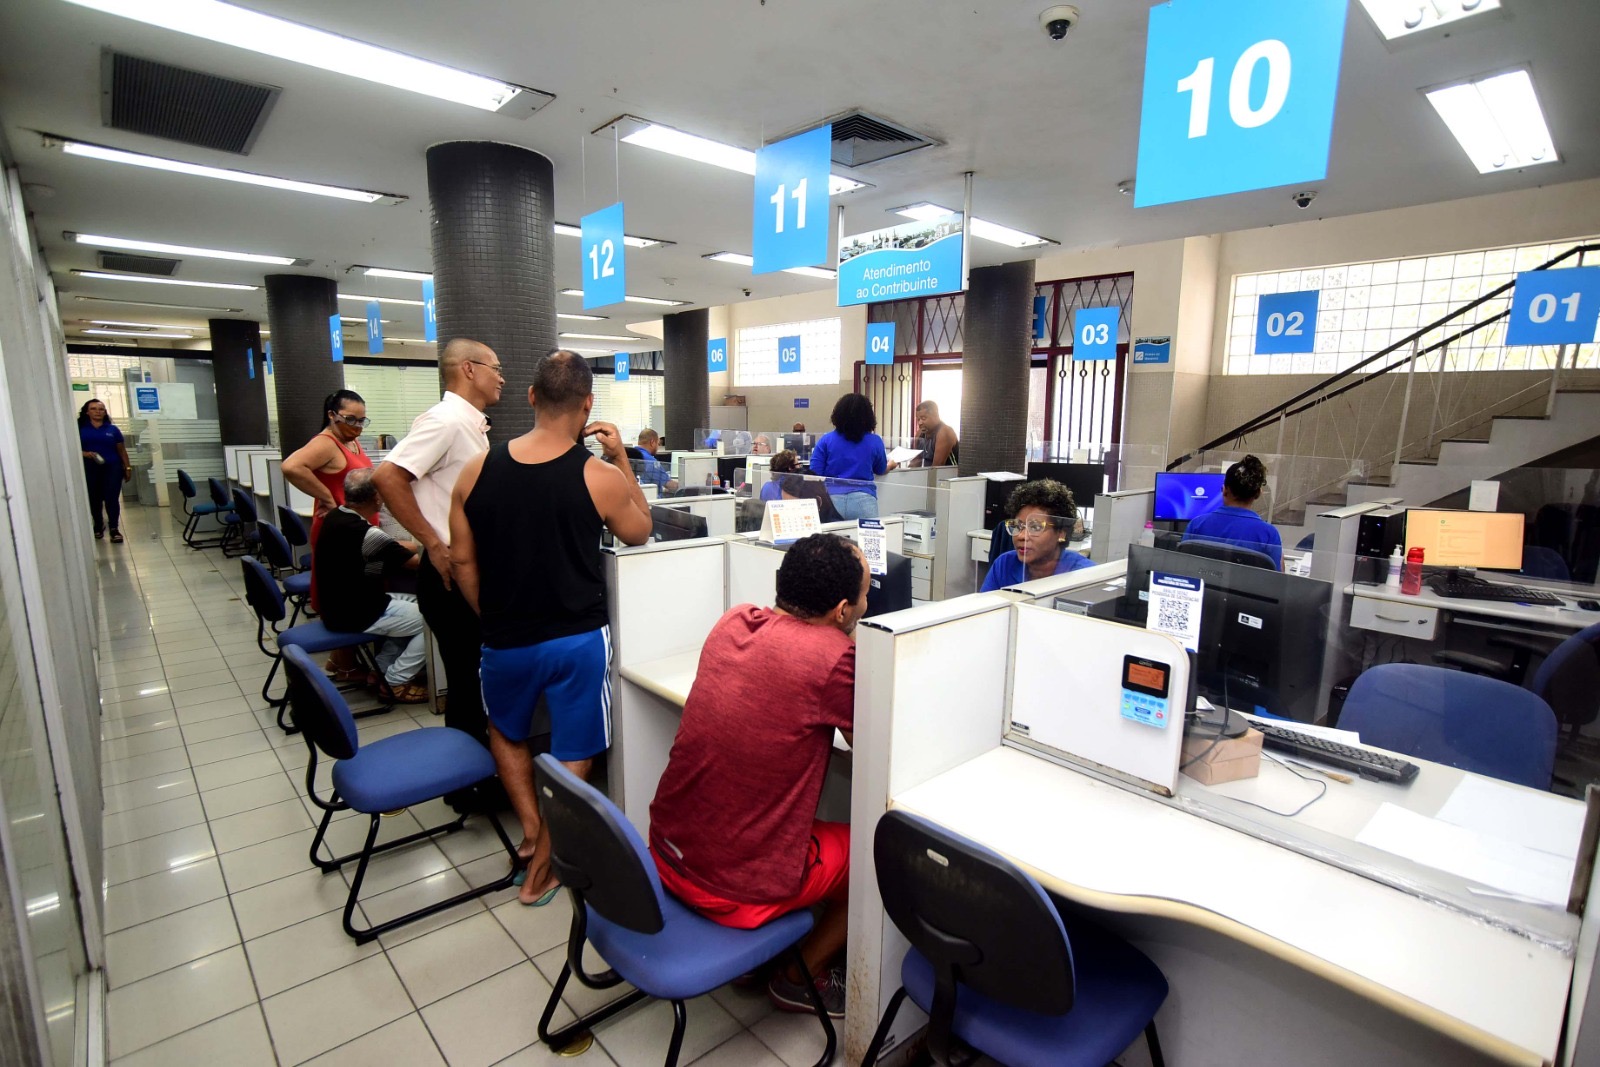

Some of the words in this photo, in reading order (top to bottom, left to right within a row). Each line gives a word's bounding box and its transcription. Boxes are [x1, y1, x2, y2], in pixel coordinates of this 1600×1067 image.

[1177, 40, 1292, 138] 10
[770, 178, 809, 233] 11
[589, 239, 615, 280] 12
[863, 259, 931, 281] Atendimento
[857, 288, 869, 299] ao
[871, 276, 939, 297] Contribuinte
[1528, 293, 1582, 324] 01
[368, 317, 379, 338] 14
[1082, 324, 1109, 346] 03
[1267, 312, 1305, 337] 02
[332, 329, 341, 349] 15
[872, 337, 890, 352] 04
[711, 349, 723, 362] 06
[782, 347, 797, 363] 05
[617, 361, 627, 373] 07
